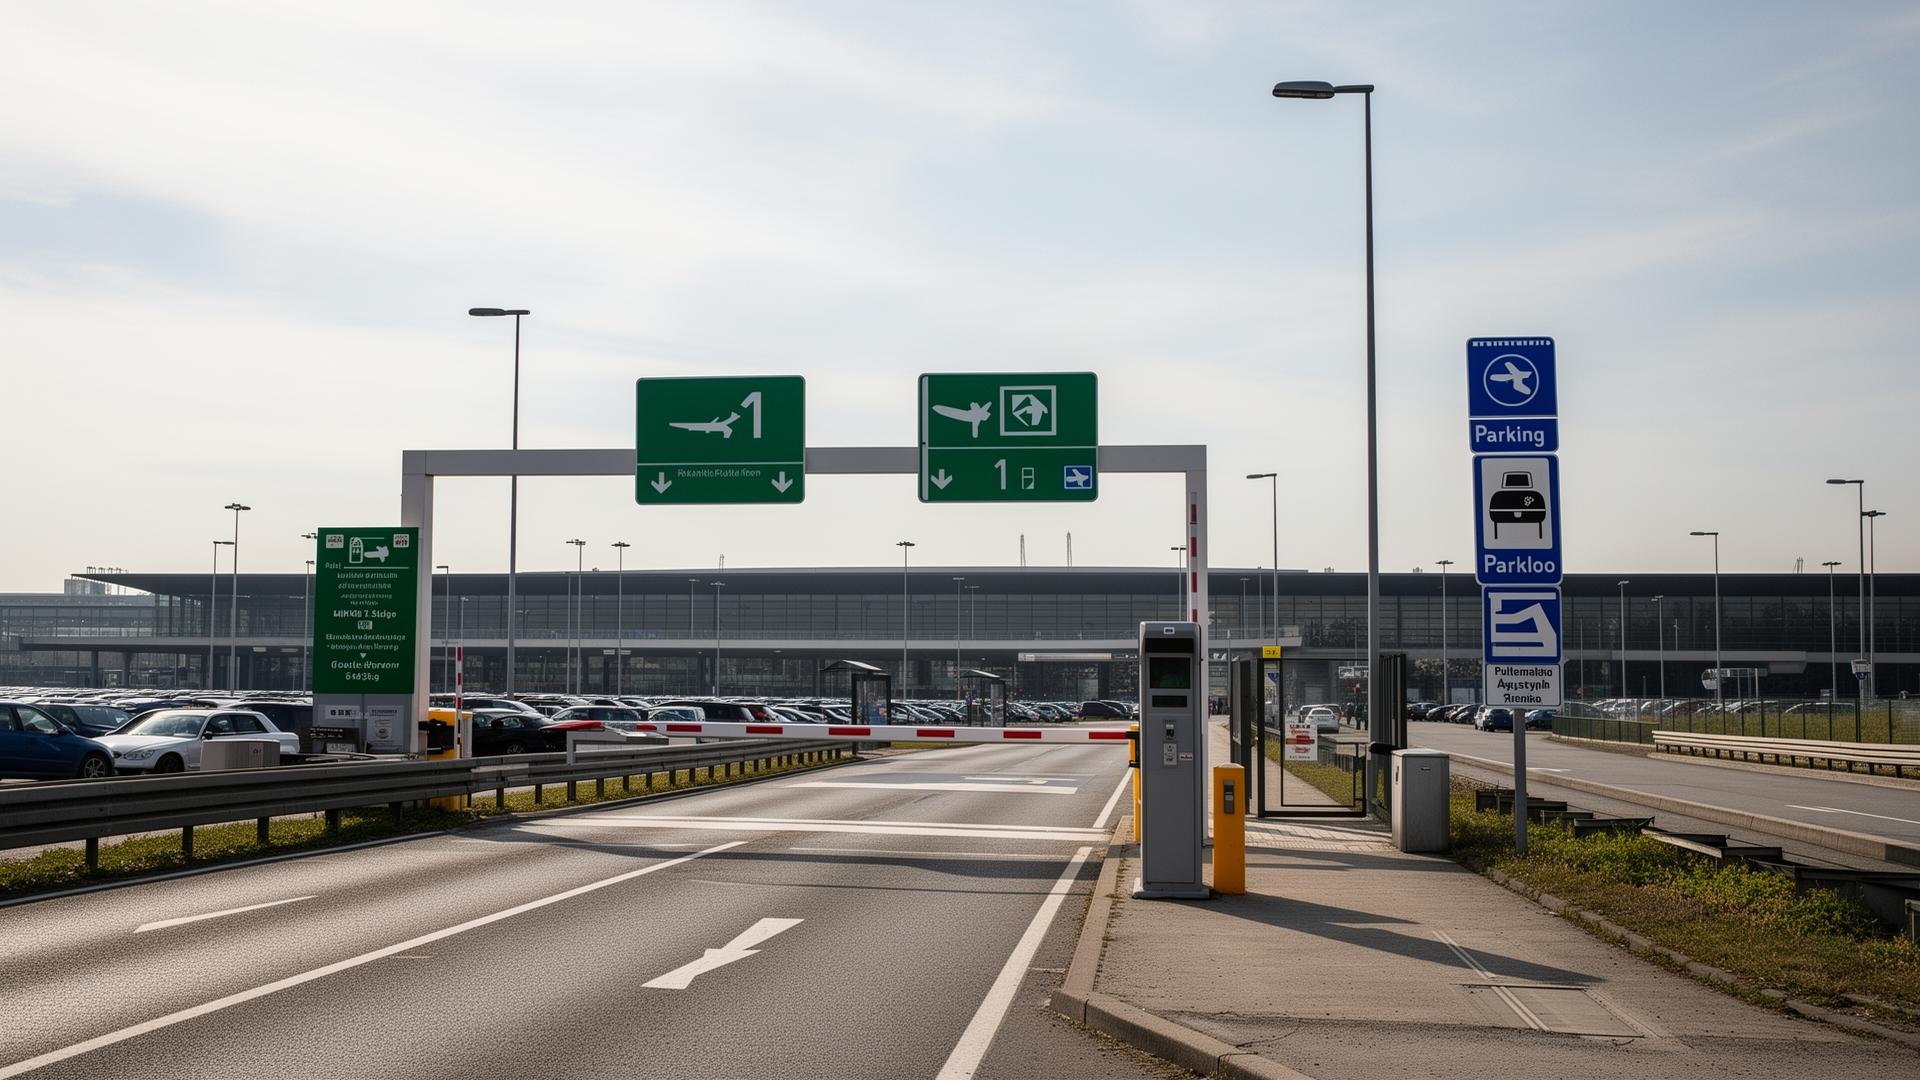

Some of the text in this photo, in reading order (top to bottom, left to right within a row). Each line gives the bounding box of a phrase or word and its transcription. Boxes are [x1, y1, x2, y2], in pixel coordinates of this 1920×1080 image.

[740, 391, 762, 439] 1
[1475, 424, 1545, 448] Parking
[994, 458, 1007, 490] 1
[1484, 554, 1556, 573] Parkloo
